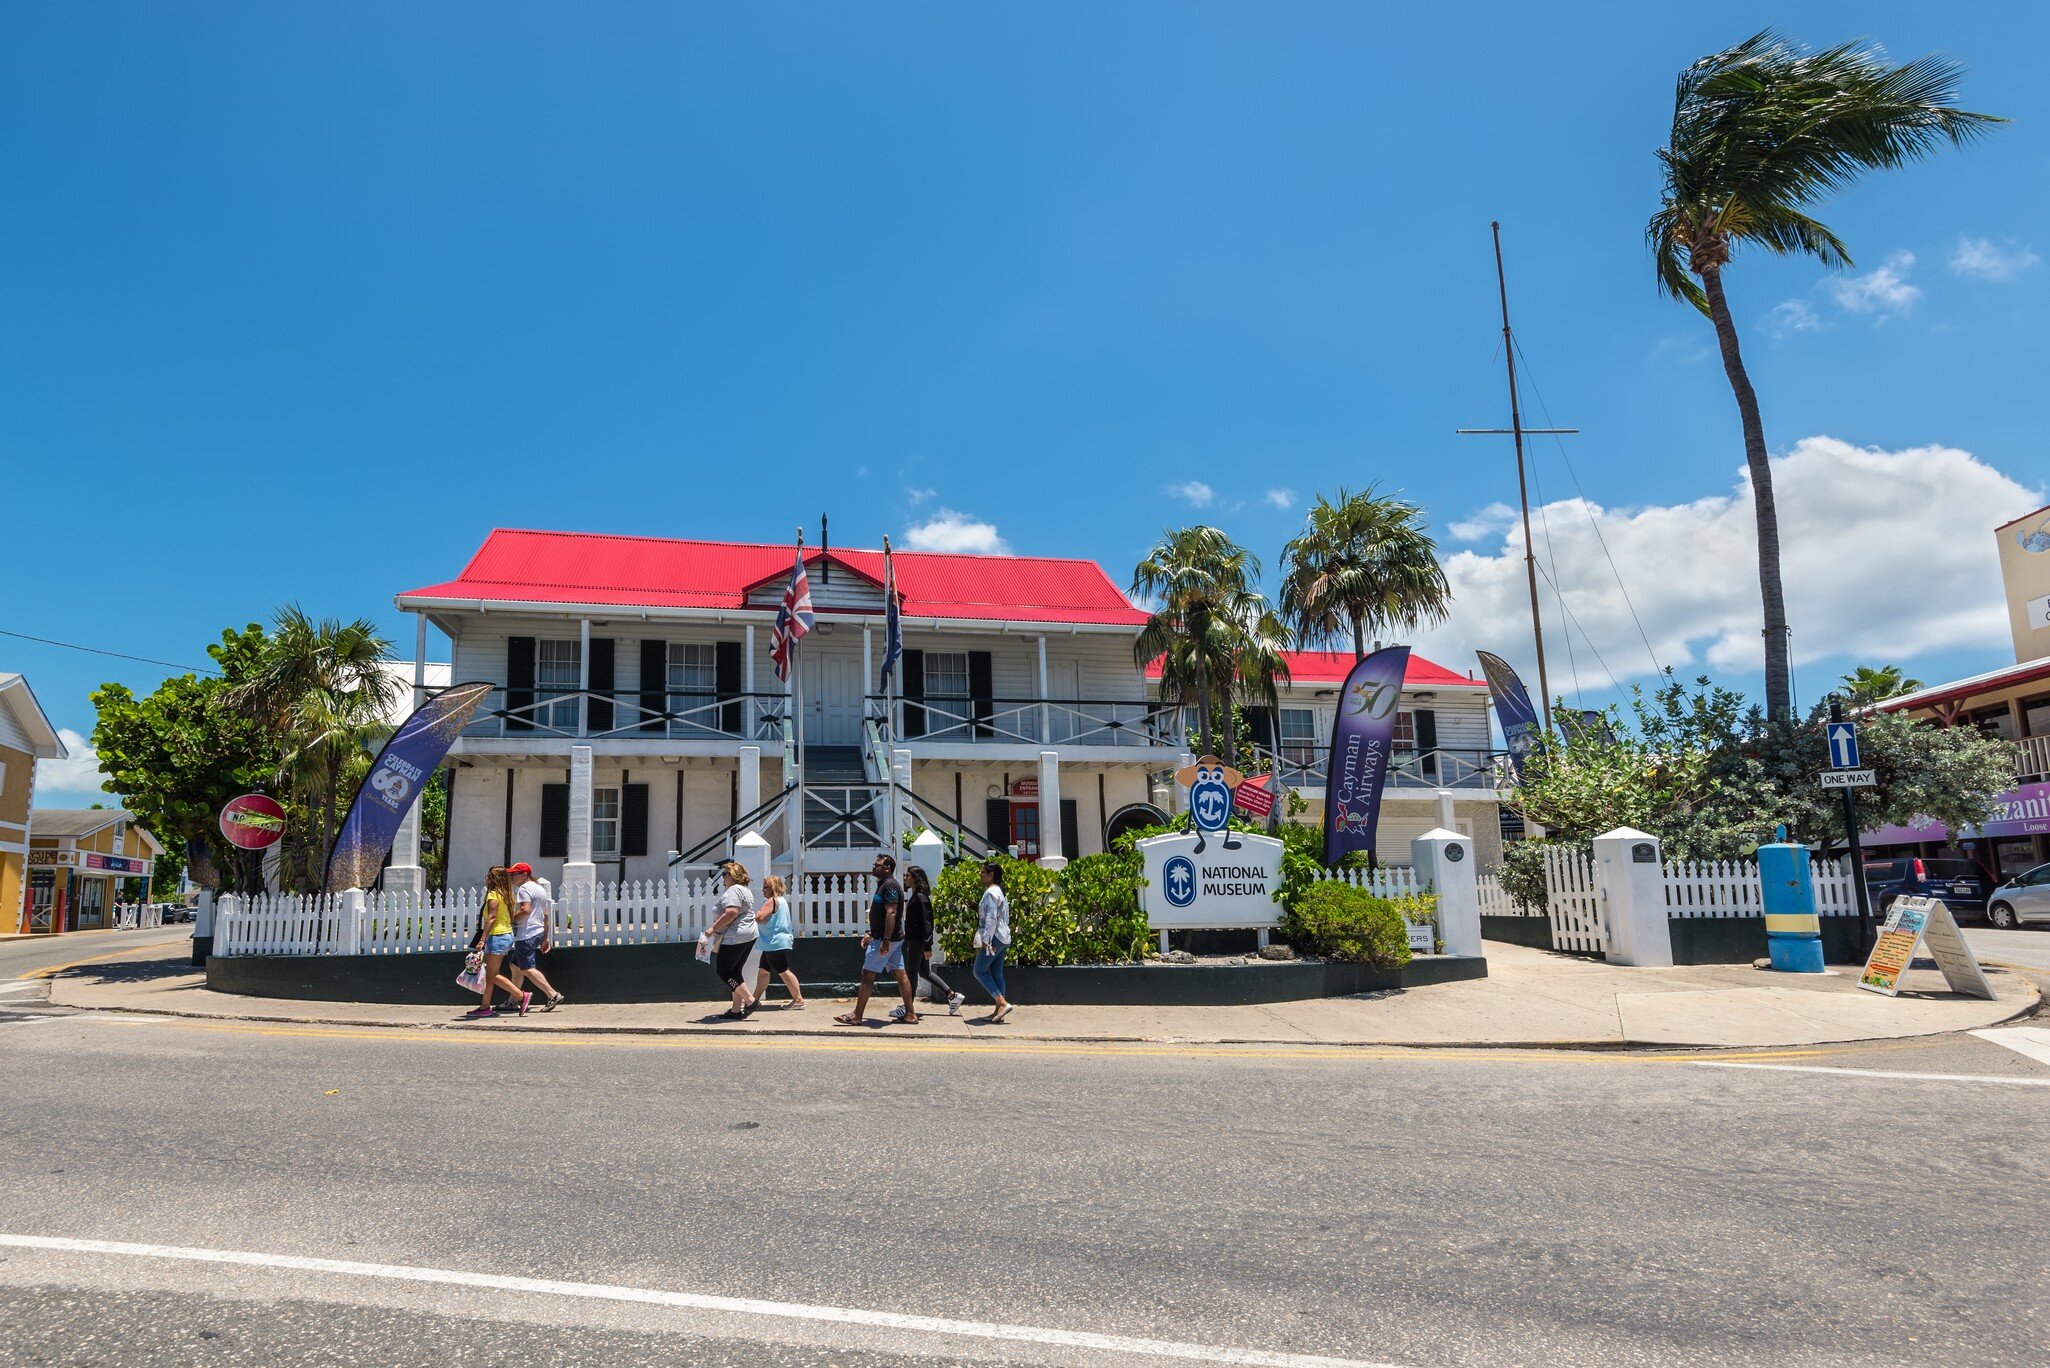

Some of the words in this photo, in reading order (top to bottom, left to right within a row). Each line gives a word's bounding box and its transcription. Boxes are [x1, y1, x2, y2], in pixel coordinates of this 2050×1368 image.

[1344, 681, 1398, 720] 50
[384, 759, 421, 782] CAYMAN
[388, 753, 423, 775] CELEBRATE
[1338, 734, 1361, 804] Cayman
[1355, 739, 1383, 806] Airways
[371, 767, 409, 800] 60
[1824, 774, 1846, 784] ONE
[1846, 773, 1871, 783] WAY
[381, 794, 400, 809] YEARS
[2023, 822, 2048, 832] Loose
[28, 850, 57, 859] YSIDE
[1202, 866, 1268, 879] NATIONAL
[1203, 883, 1266, 896] MUSEUM
